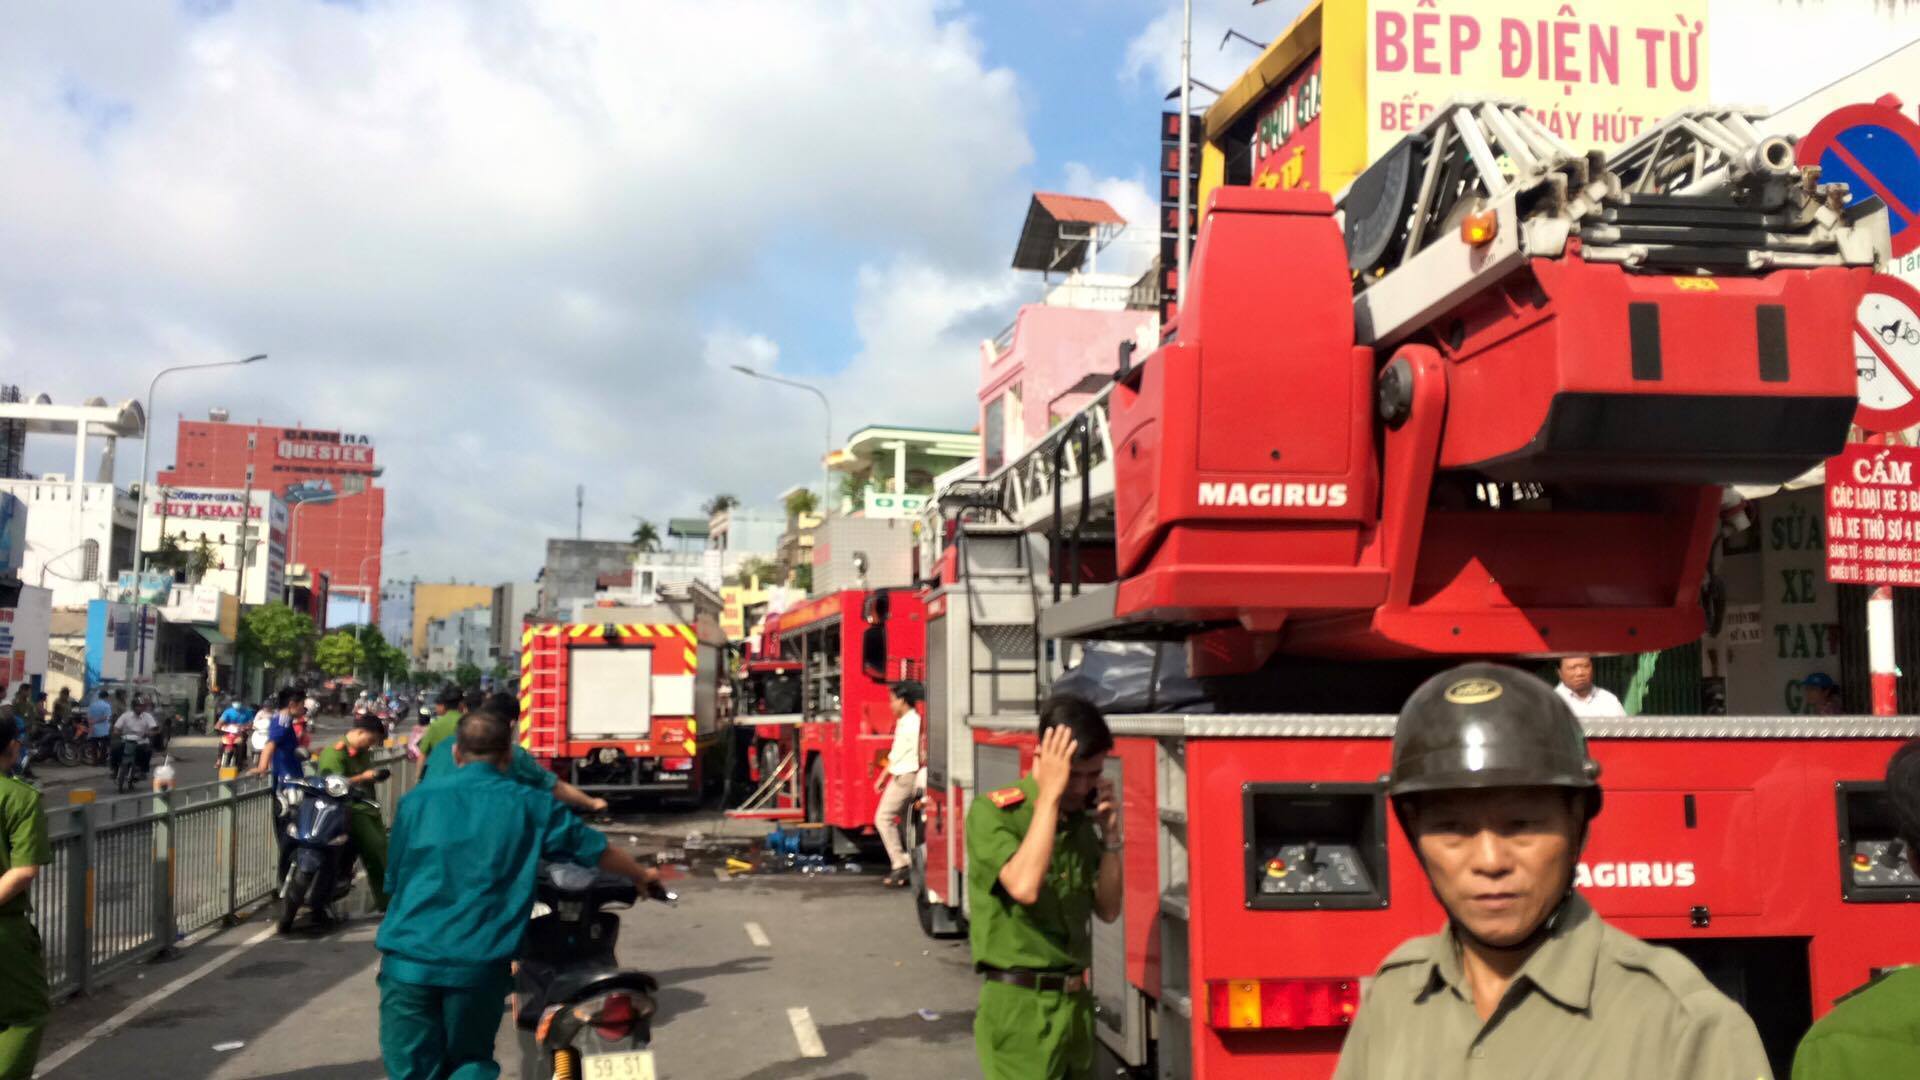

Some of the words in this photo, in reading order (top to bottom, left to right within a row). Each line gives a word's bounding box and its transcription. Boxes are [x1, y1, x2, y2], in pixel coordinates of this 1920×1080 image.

[1499, 4, 1619, 96] ĐIỆN
[1636, 13, 1704, 92] TỪ
[1592, 107, 1643, 143] HÚT
[278, 441, 367, 462] QUESTEK
[1853, 449, 1913, 485] CẤM
[1198, 482, 1348, 507] MAGIRUS
[1832, 480, 1855, 508] CÁC
[1856, 486, 1880, 514] LOẠI
[1883, 489, 1897, 511] XE
[1900, 490, 1908, 511] 3
[1829, 512, 1844, 538] VÀ
[1847, 517, 1861, 539] XE
[1863, 514, 1885, 540] THÔ
[1904, 521, 1912, 541] 4
[1781, 568, 1815, 604] XE
[1775, 623, 1826, 658] TAY
[1574, 862, 1696, 887] AGIRUS
